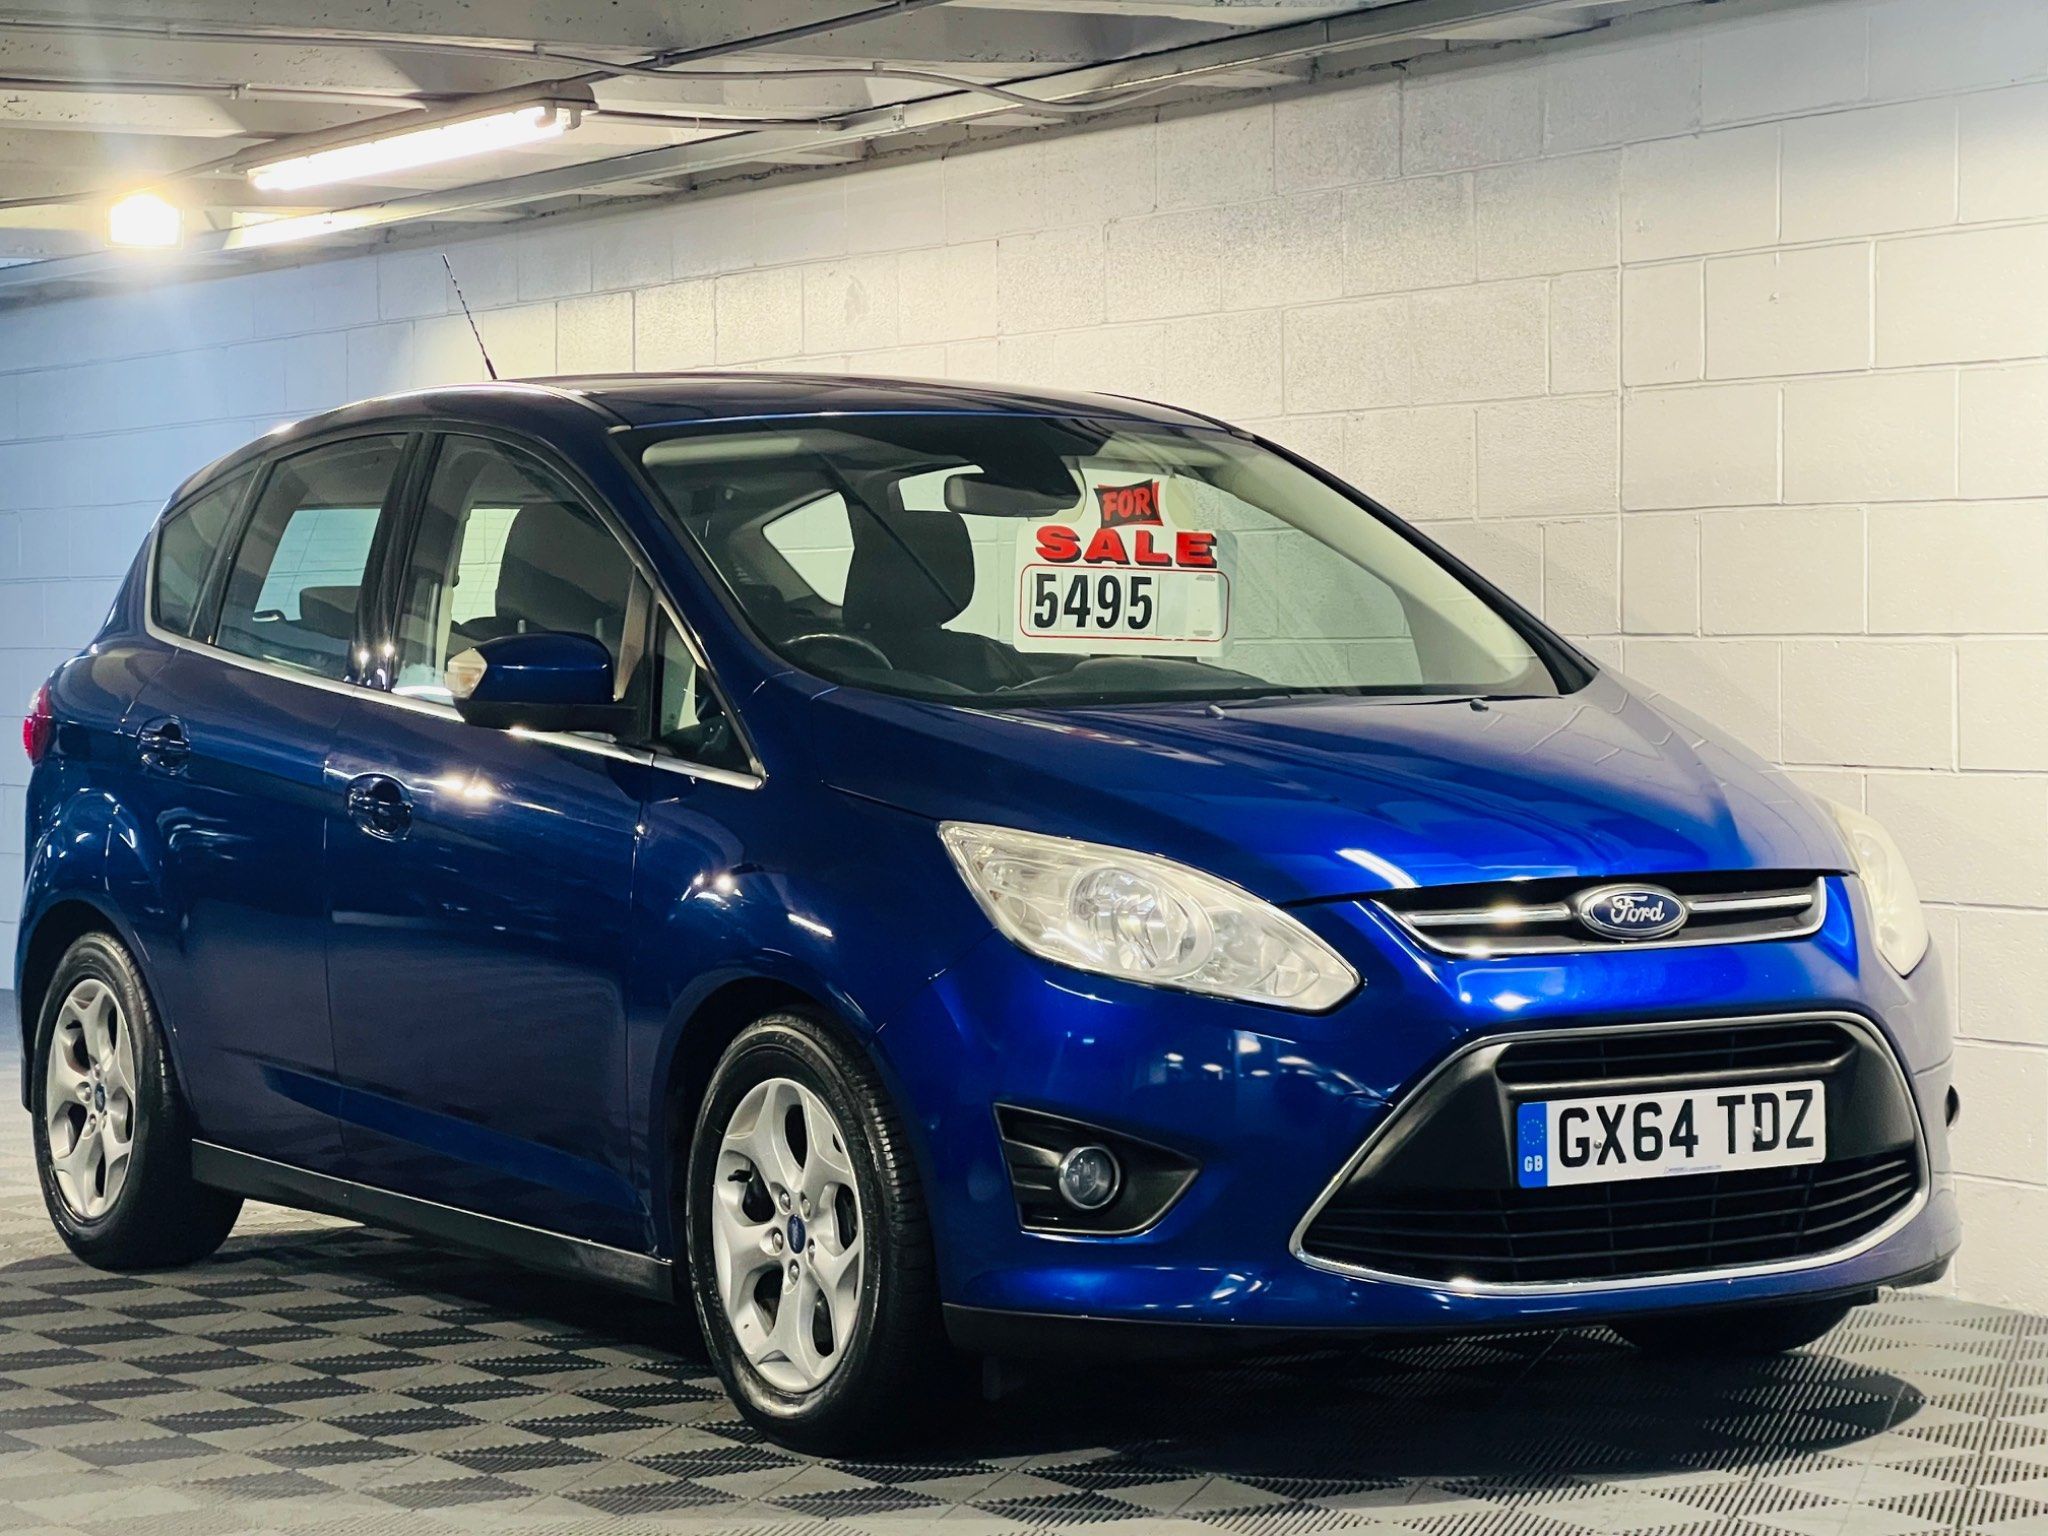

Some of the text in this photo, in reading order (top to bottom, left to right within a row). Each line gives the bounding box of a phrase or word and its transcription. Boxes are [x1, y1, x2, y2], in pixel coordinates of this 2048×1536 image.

[1102, 488, 1152, 521] FOR
[1035, 525, 1218, 568] SALE
[1034, 573, 1153, 630] 5495
[1611, 895, 1665, 924] Ford
[1558, 1089, 1814, 1168] GX64 TDZ
[1524, 1155, 1543, 1172] GB
